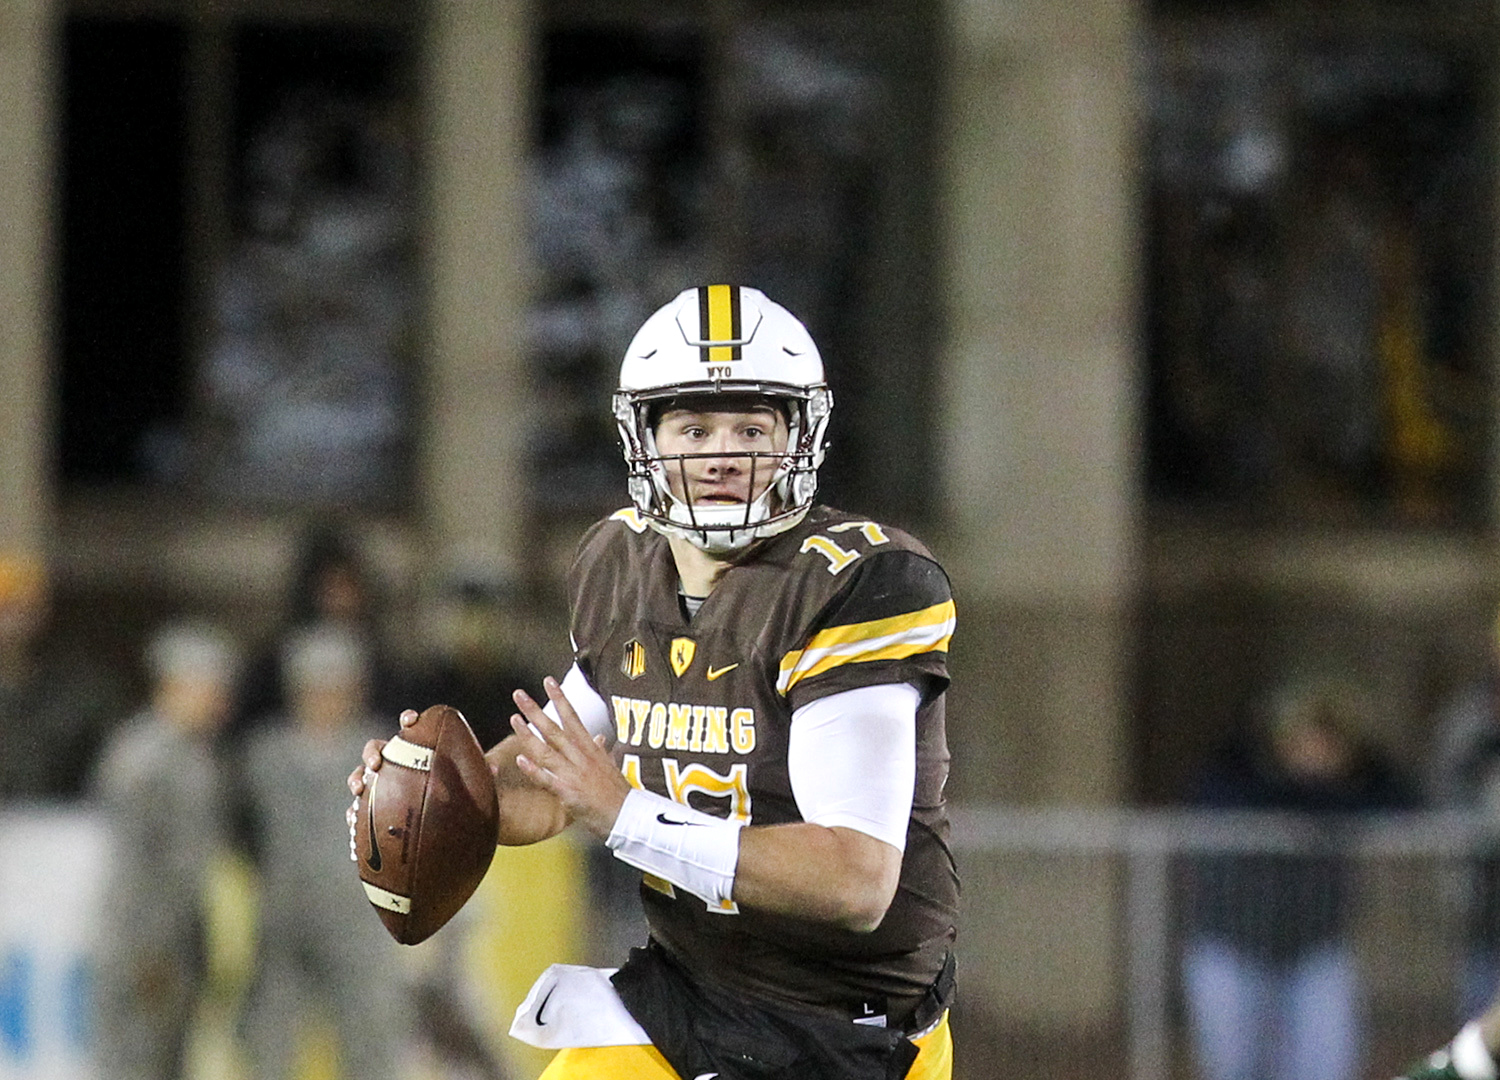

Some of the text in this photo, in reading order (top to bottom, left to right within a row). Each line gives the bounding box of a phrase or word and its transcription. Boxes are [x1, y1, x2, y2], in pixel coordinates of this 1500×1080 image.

[706, 366, 732, 378] WYO
[799, 521, 890, 576] 17
[611, 695, 756, 755] WYOMING
[863, 1002, 875, 1015] L
